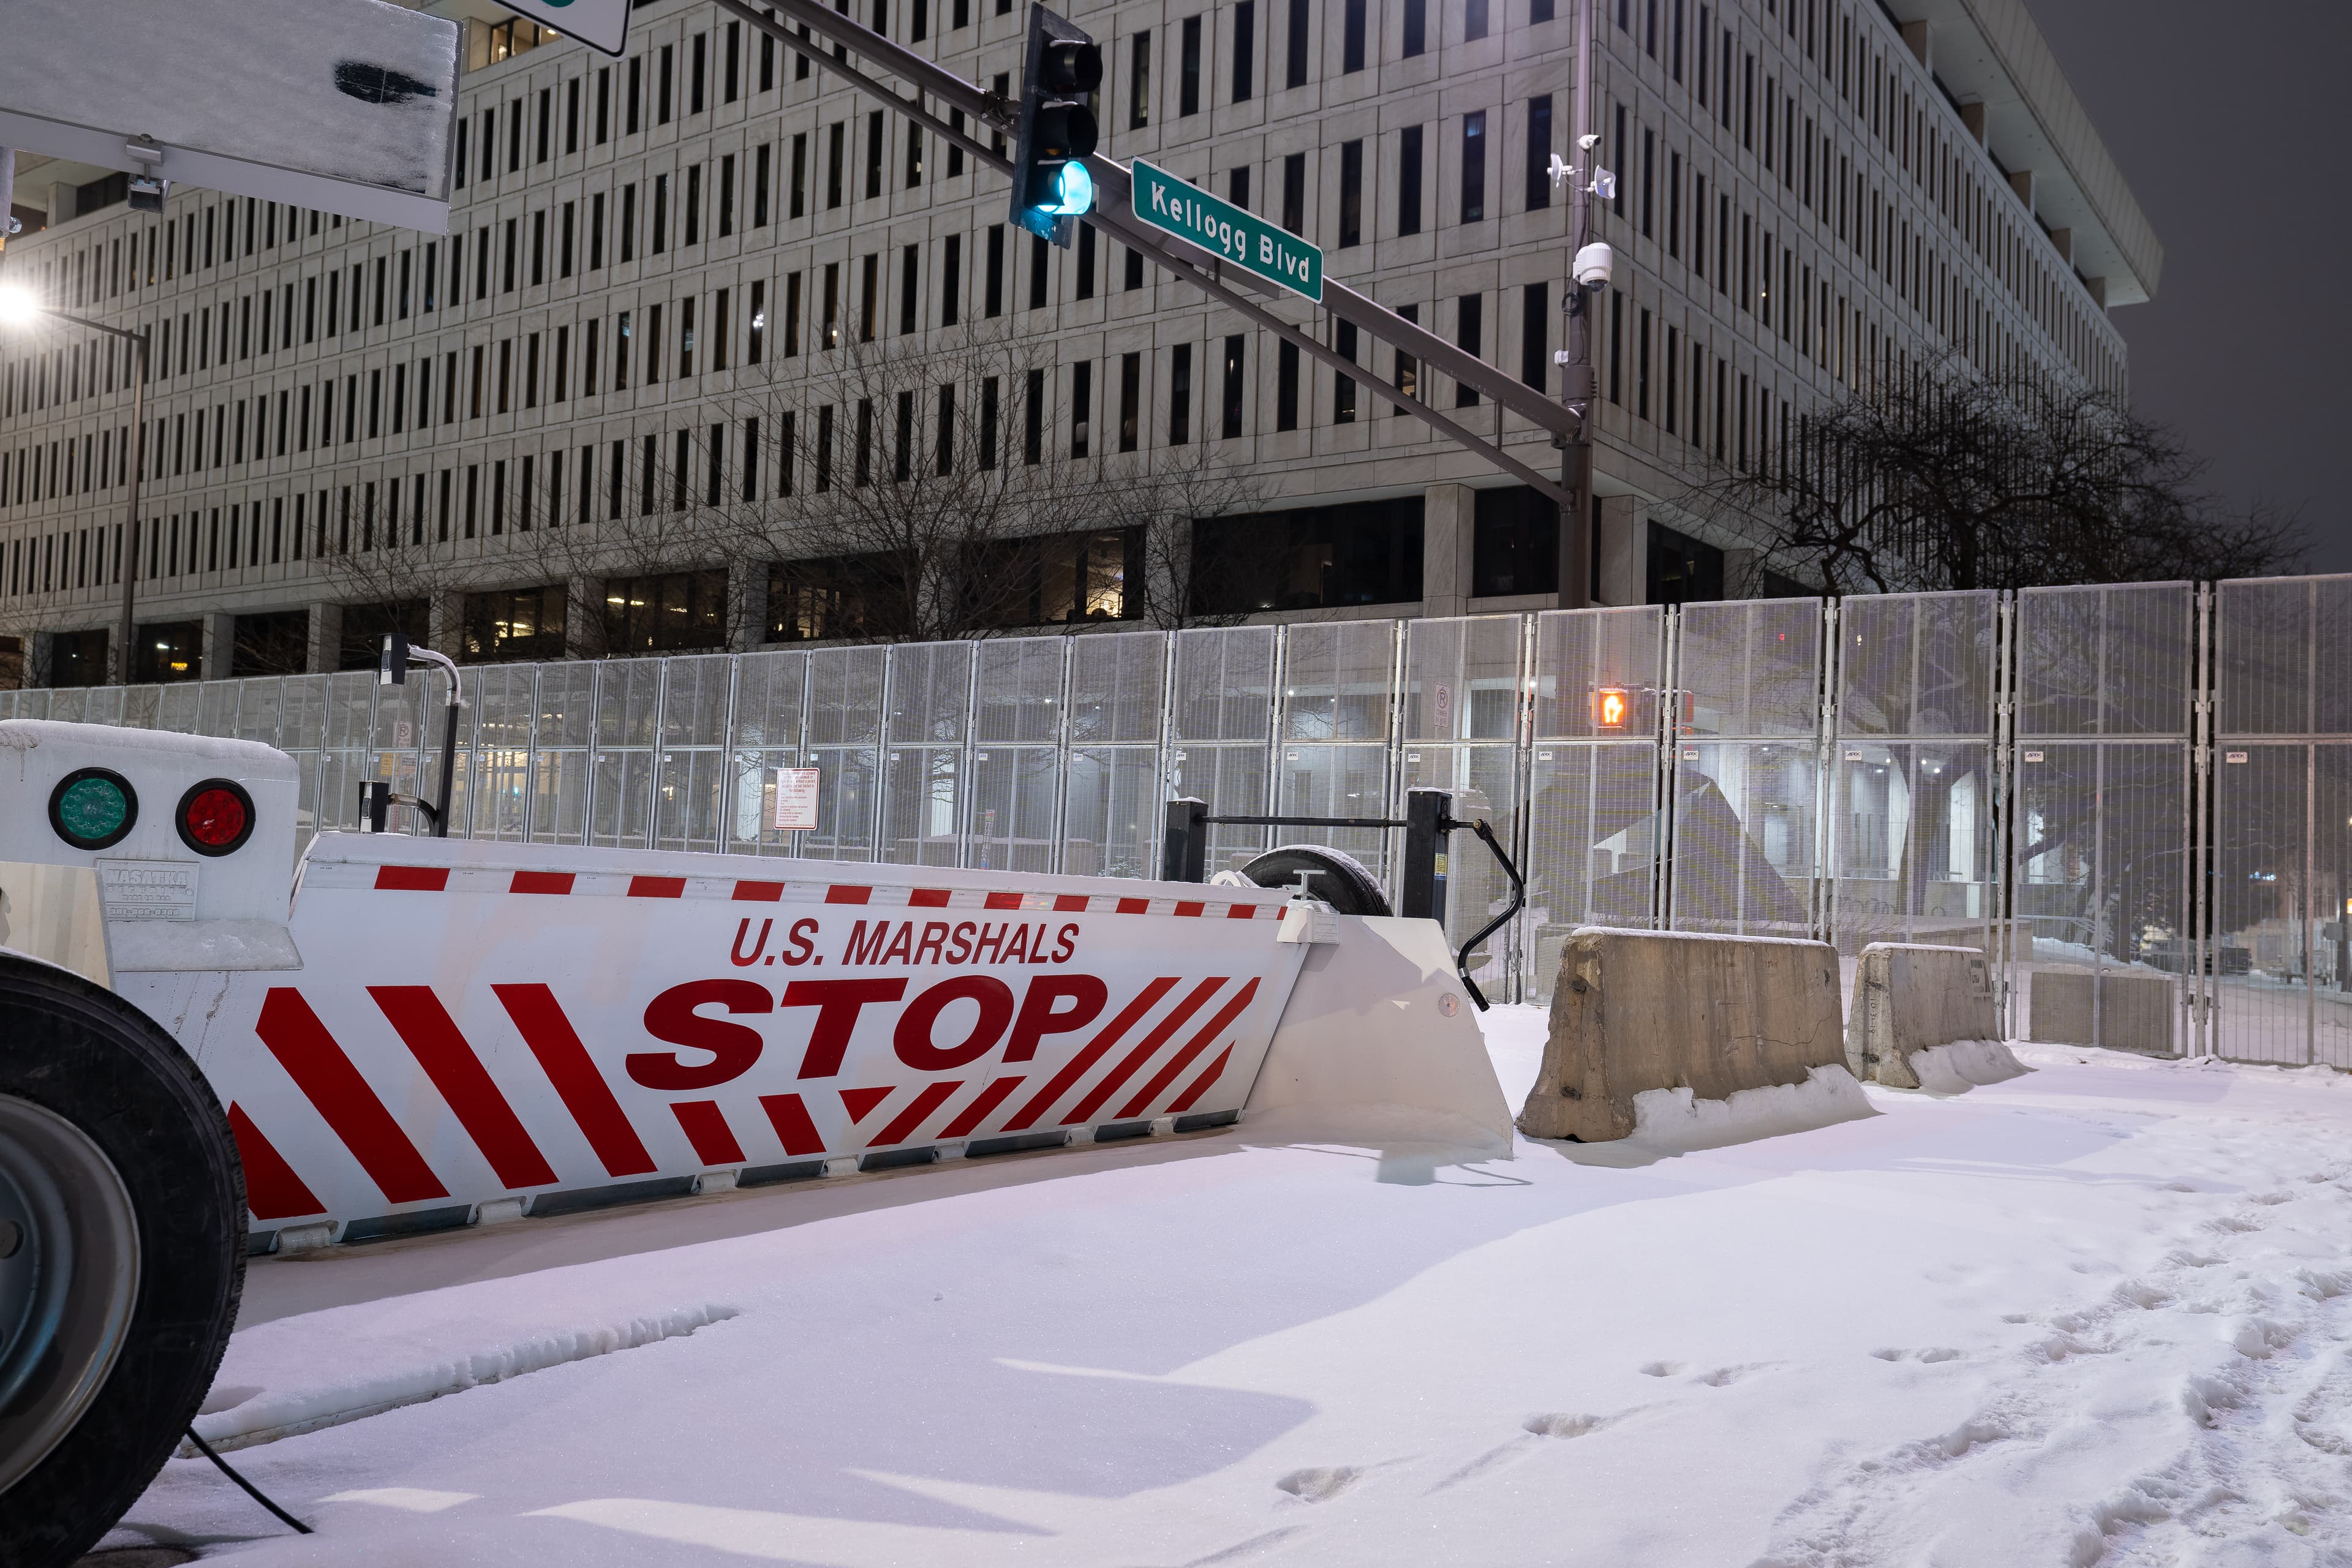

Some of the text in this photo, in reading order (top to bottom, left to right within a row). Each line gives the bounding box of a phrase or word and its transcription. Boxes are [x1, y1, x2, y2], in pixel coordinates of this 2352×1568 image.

[1152, 181, 1310, 283] Kellogg Blvd
[107, 869, 189, 886] NASATKA
[731, 918, 1080, 967] U.S. MARSHALS
[625, 975, 1108, 1090] STOP
